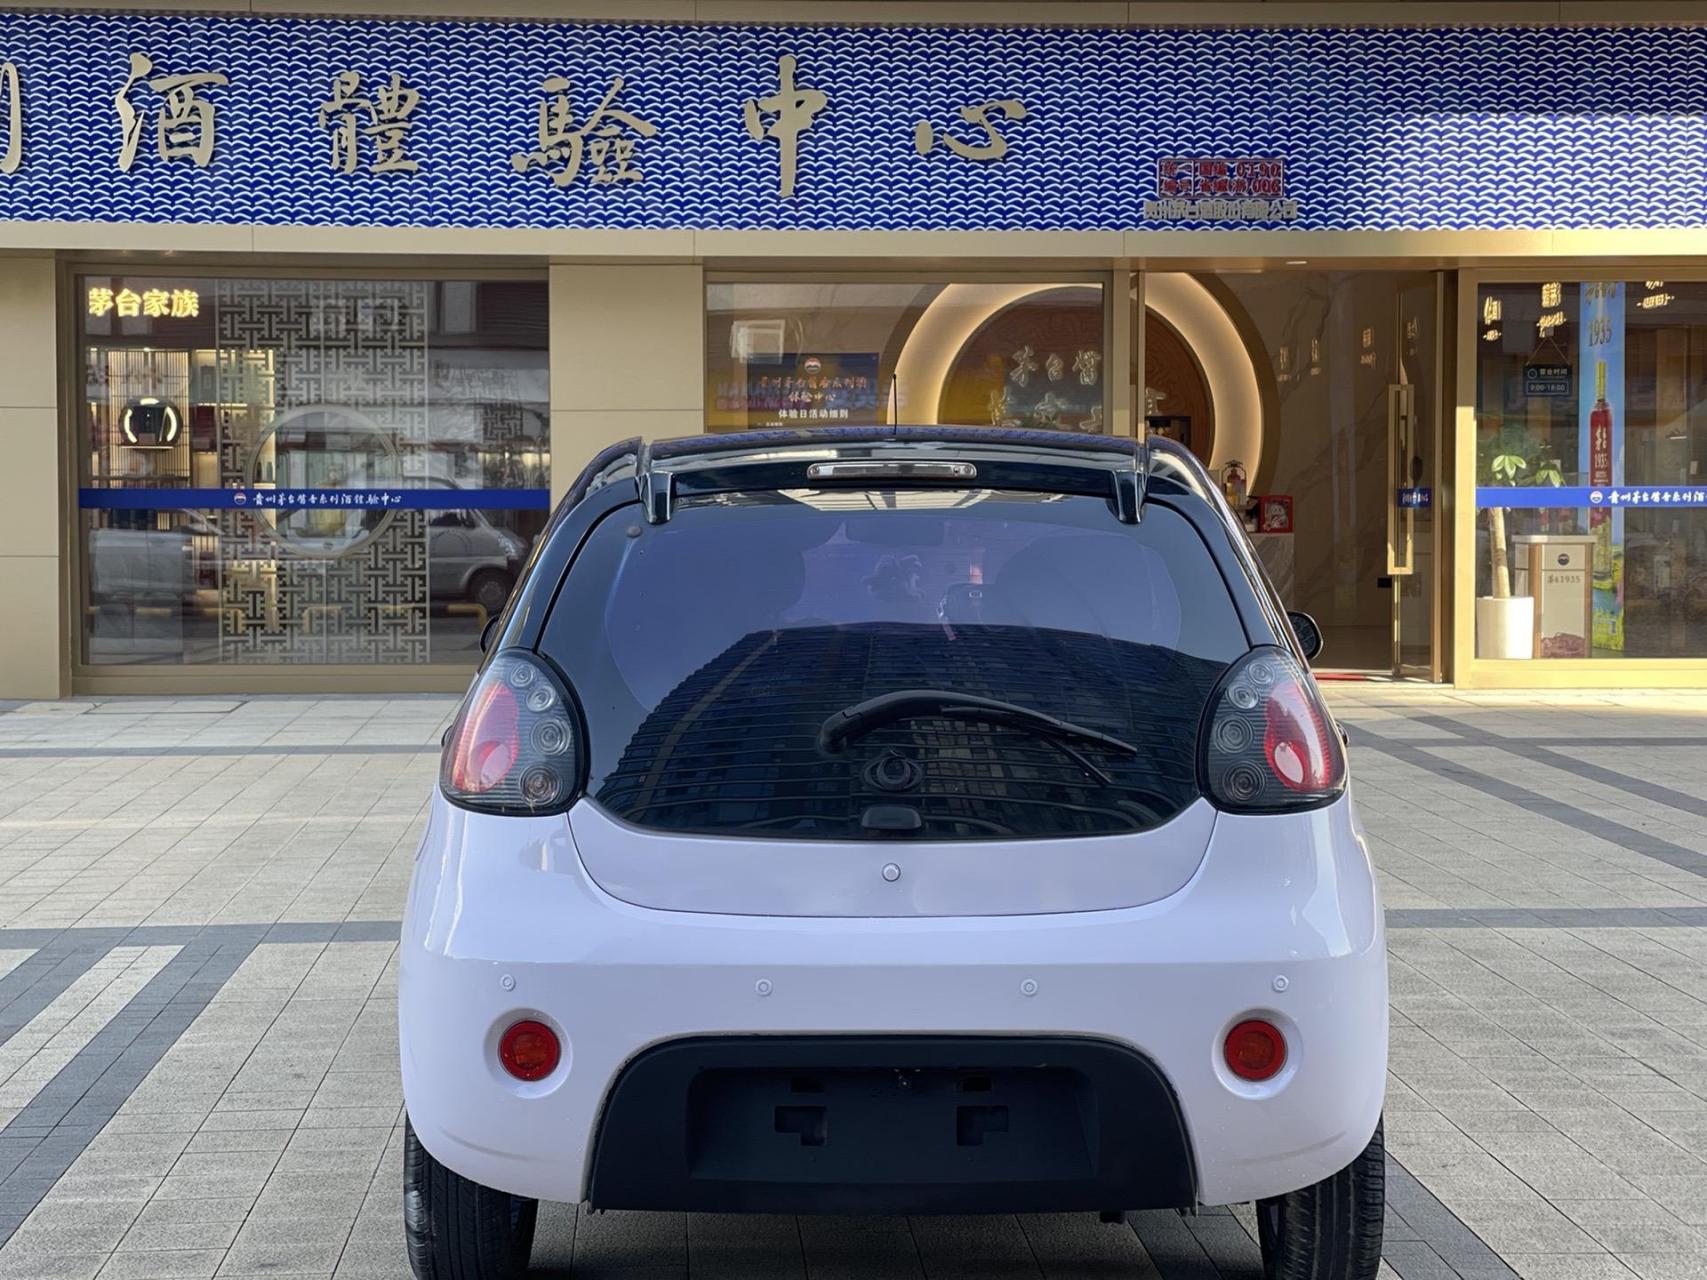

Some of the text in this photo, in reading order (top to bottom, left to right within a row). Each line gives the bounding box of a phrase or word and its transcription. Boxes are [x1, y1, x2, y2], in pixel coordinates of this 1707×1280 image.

[0, 53, 1027, 198] 酒體驗中心
[89, 287, 199, 318] 茅台家族
[778, 409, 849, 419] 体验日活动细则
